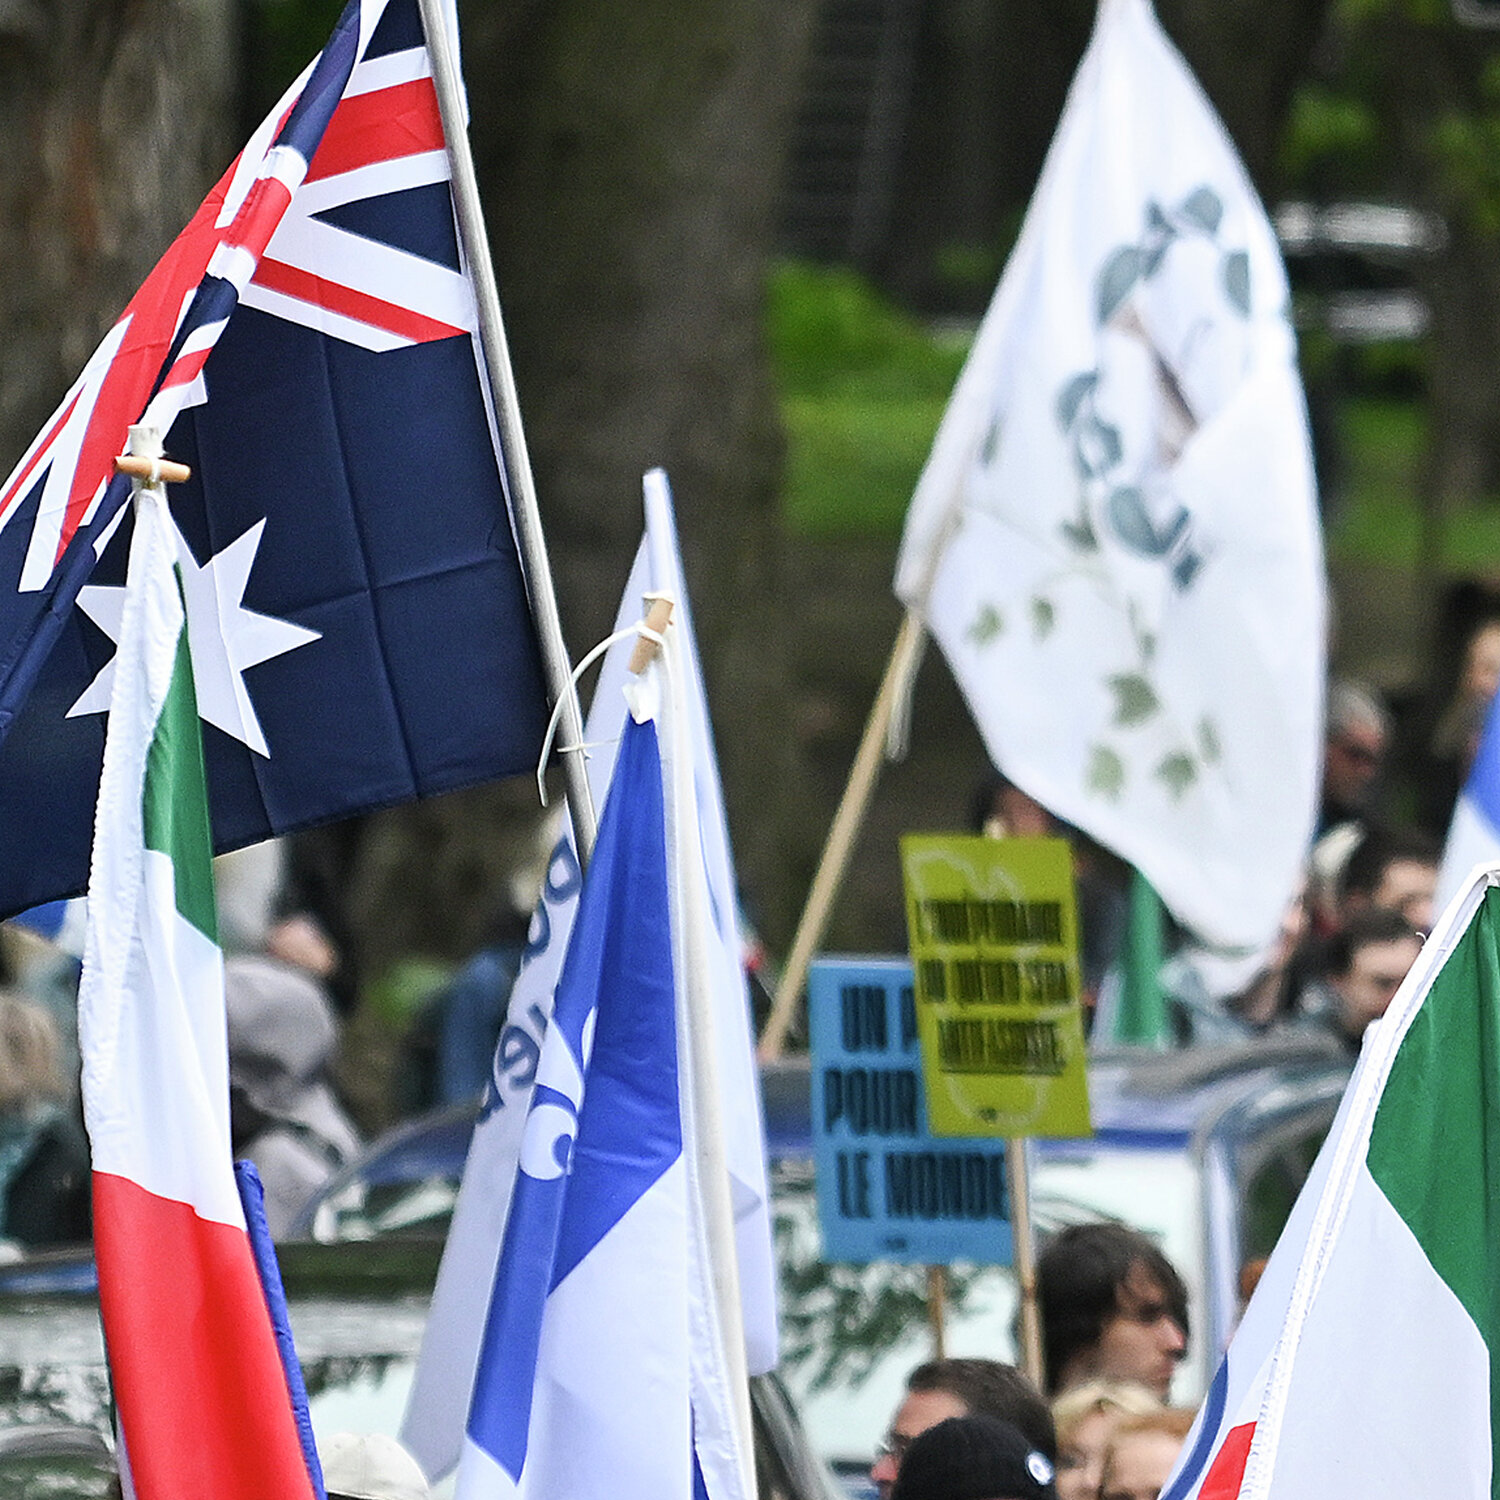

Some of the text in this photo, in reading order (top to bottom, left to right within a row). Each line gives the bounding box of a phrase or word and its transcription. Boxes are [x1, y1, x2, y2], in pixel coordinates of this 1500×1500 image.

[824, 1068, 917, 1137] POUR
[837, 1151, 872, 1220] LE
[884, 1151, 1008, 1223] MONDE
